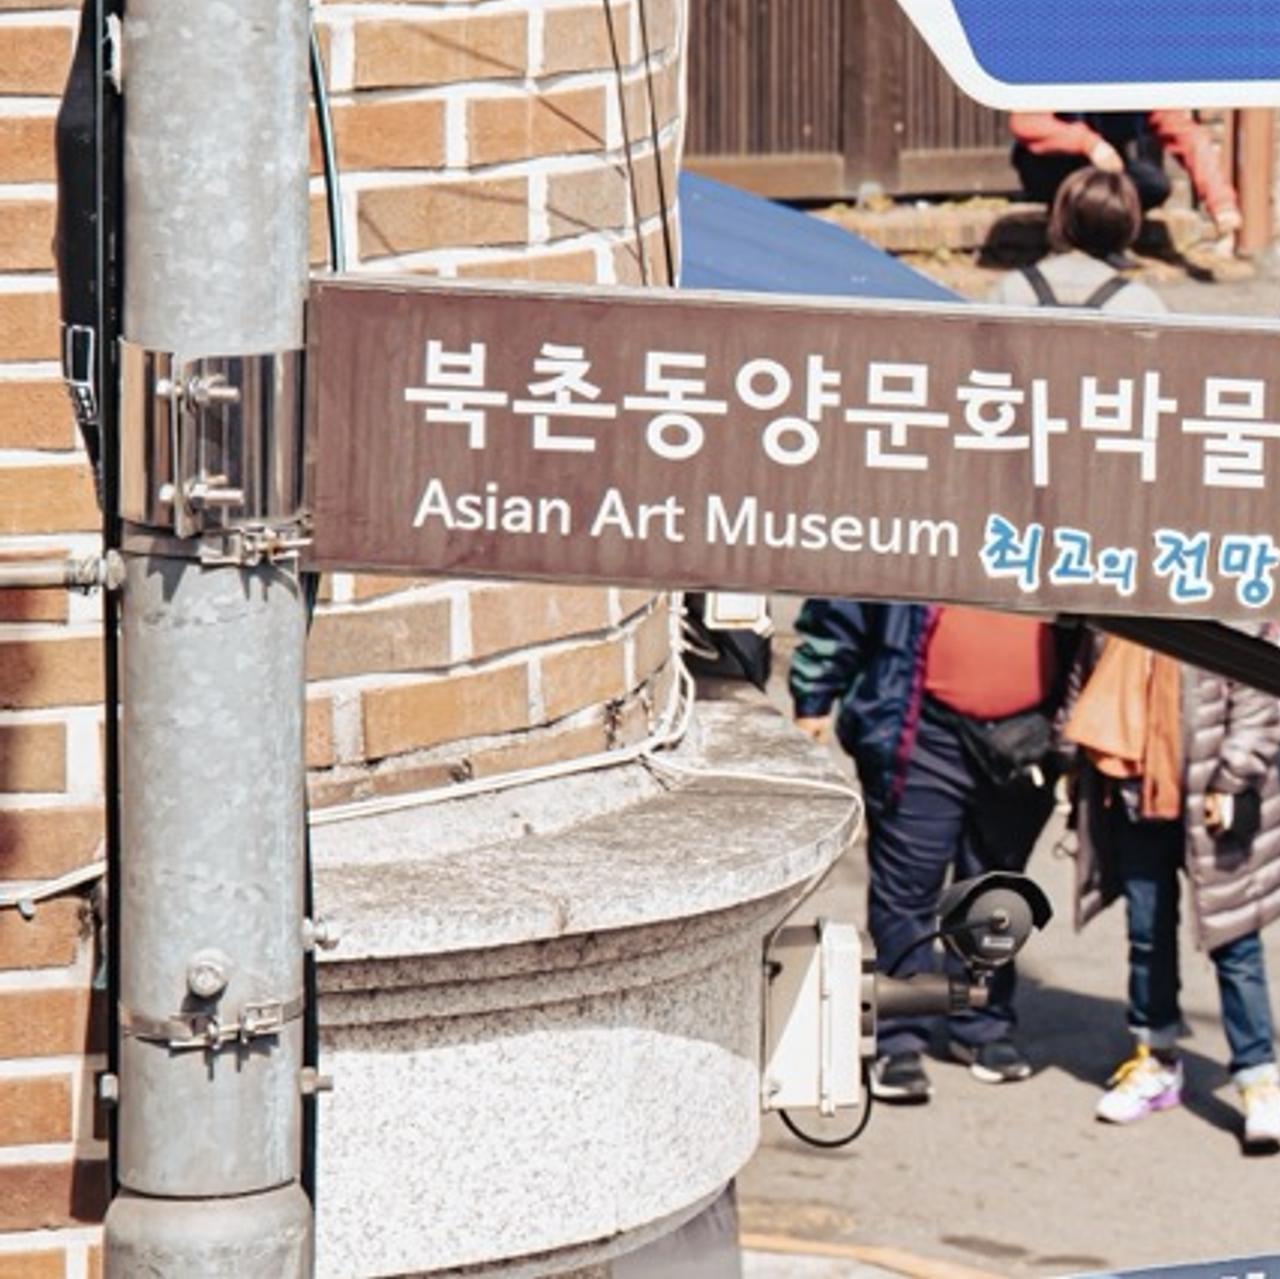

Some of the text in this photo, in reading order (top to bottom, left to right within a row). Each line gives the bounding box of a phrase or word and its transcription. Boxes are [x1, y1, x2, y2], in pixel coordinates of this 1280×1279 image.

[414, 479, 958, 556] Asian Art Museum
[979, 513, 1137, 596] 최고의
